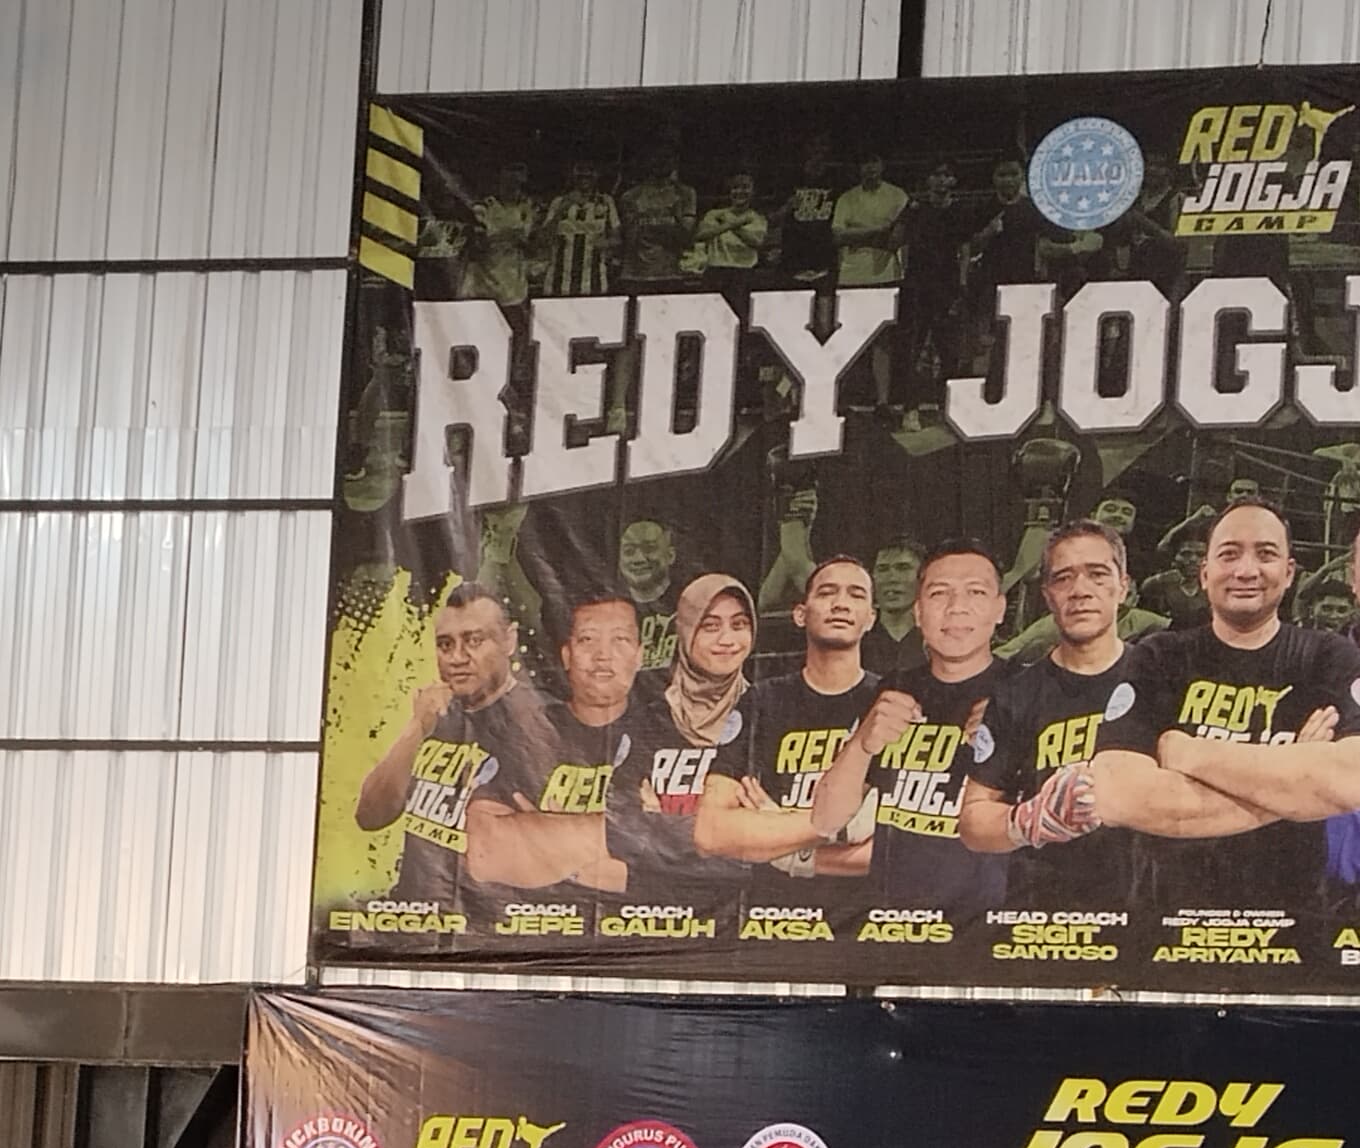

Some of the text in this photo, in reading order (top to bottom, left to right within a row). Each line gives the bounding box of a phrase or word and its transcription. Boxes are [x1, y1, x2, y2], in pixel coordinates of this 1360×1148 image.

[1050, 161, 1126, 187] WAKO
[1182, 160, 1353, 211] JOGJA
[1192, 214, 1319, 233] CAMP
[402, 288, 900, 520] REDY
[881, 770, 968, 817] JOGJ
[889, 811, 960, 834] CAM
[367, 900, 439, 914] COACH
[505, 902, 577, 917] COACH
[621, 905, 694, 919] COACH
[750, 906, 822, 921] COACH
[871, 909, 944, 924] COACH
[330, 911, 467, 934] ENGGAR
[496, 916, 584, 936] JEPE
[600, 917, 716, 939] GALUH
[986, 910, 1128, 927] HEAD COACH
[1162, 917, 1200, 926] REDY
[740, 921, 835, 941] AKSA
[858, 922, 954, 943] AGUS
[1012, 925, 1101, 945] SIGIT
[1181, 927, 1278, 947] REDY
[992, 944, 1119, 962] SANTOSO
[1154, 947, 1302, 964] APRIYANTA
[1042, 1077, 1286, 1128] REDY
[762, 1128, 802, 1142] PEMUDA
